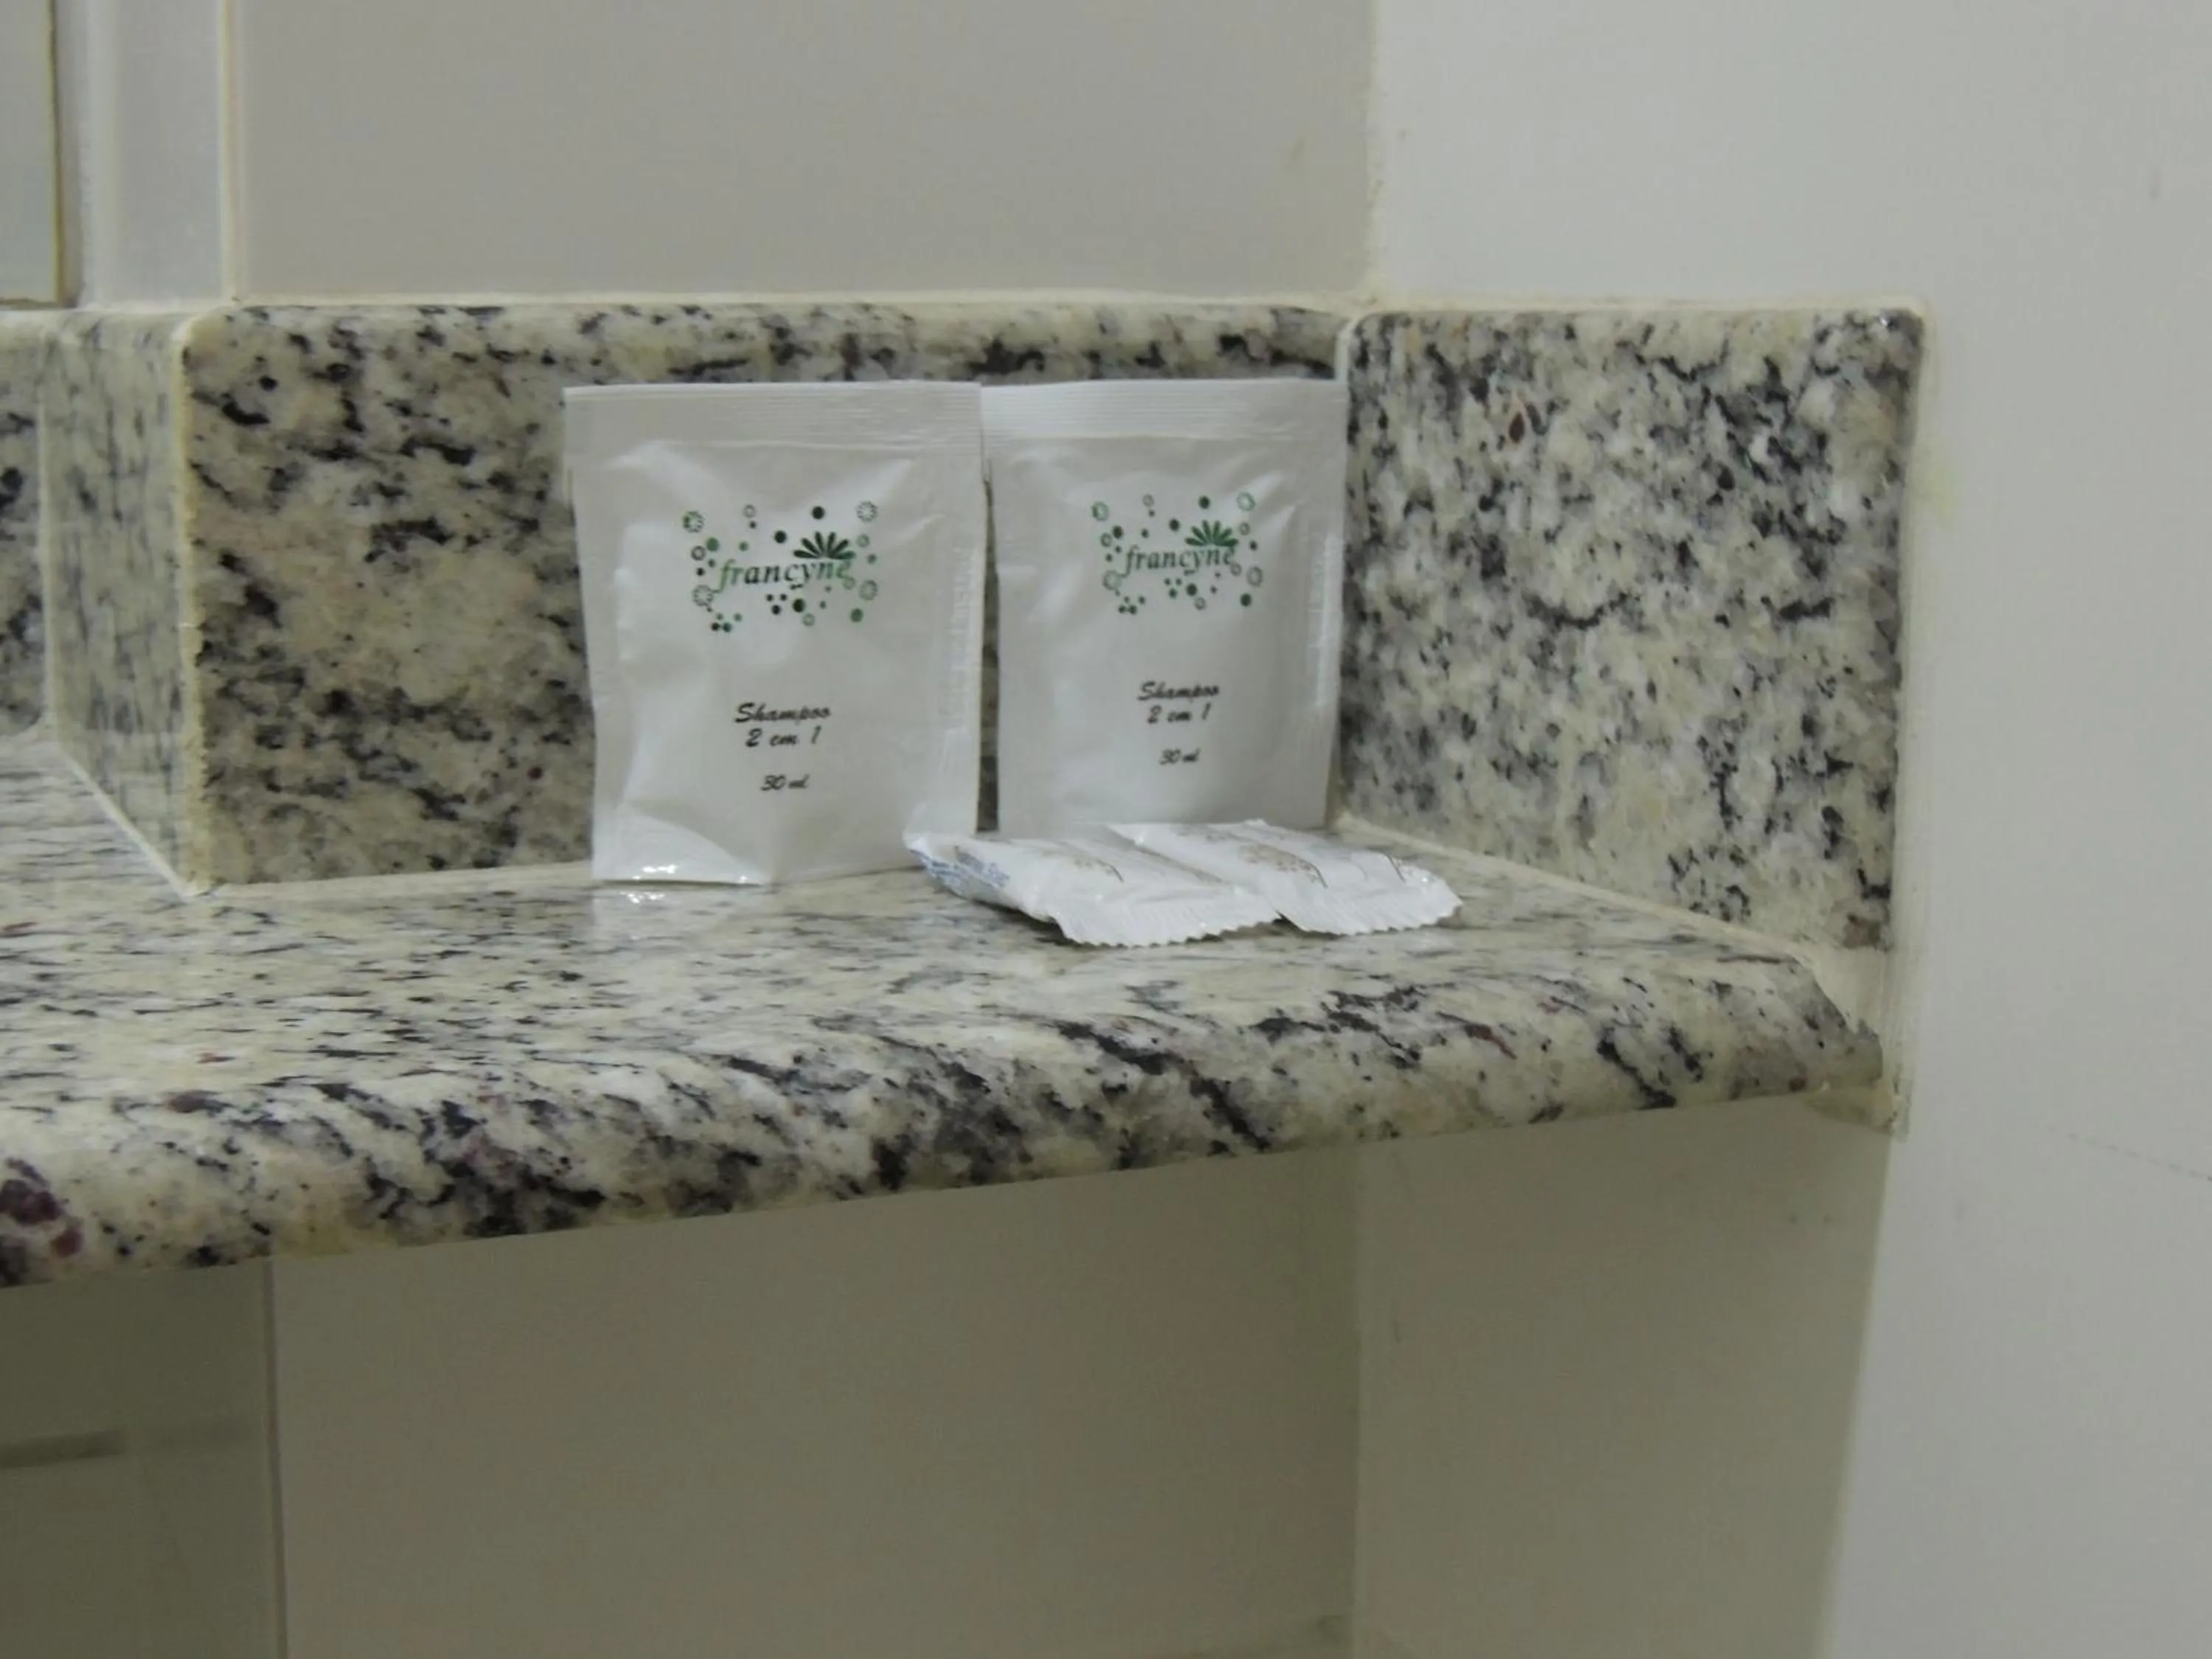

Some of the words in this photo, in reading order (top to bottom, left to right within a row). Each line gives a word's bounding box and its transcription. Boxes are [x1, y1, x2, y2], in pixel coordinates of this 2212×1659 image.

[735, 702, 831, 726] Shampoo
[1147, 704, 1162, 725] 2
[745, 727, 762, 748] 2
[761, 774, 786, 791] 30
